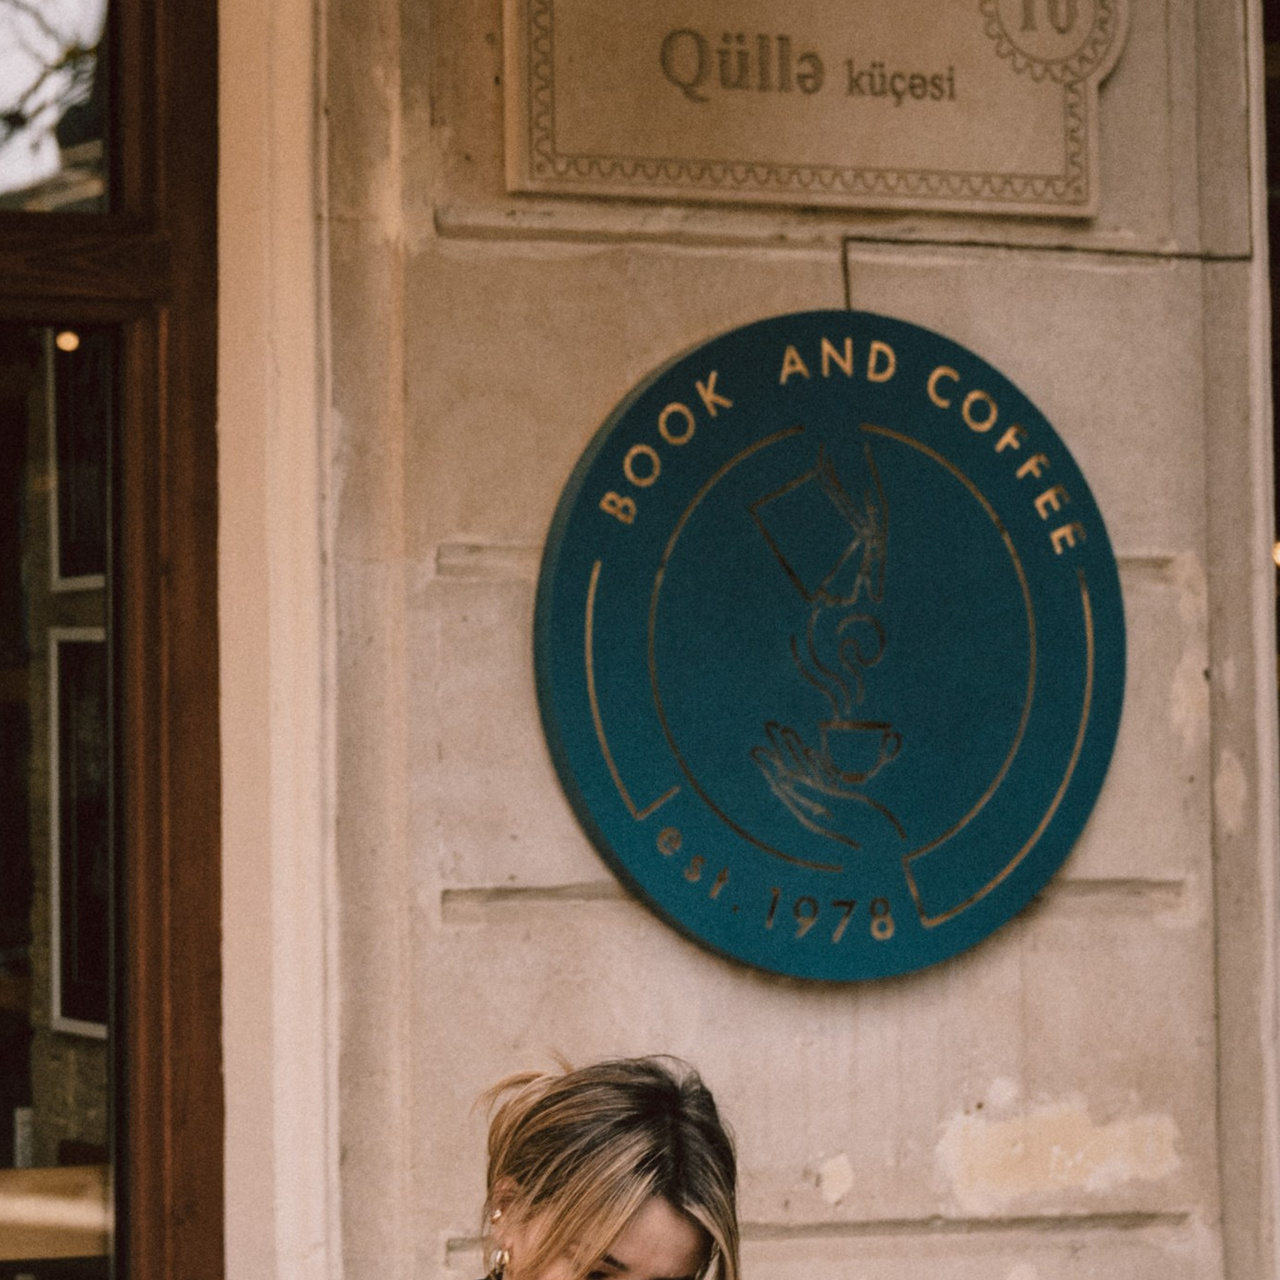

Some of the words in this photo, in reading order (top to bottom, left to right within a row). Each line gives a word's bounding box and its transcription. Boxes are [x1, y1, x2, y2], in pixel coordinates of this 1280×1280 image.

[658, 27, 825, 104] Qüllə
[846, 57, 956, 108] küçəsi
[599, 370, 733, 524] BOOK
[779, 336, 897, 385] AND
[926, 365, 1087, 555] COFFEE
[765, 886, 895, 944] 1978
